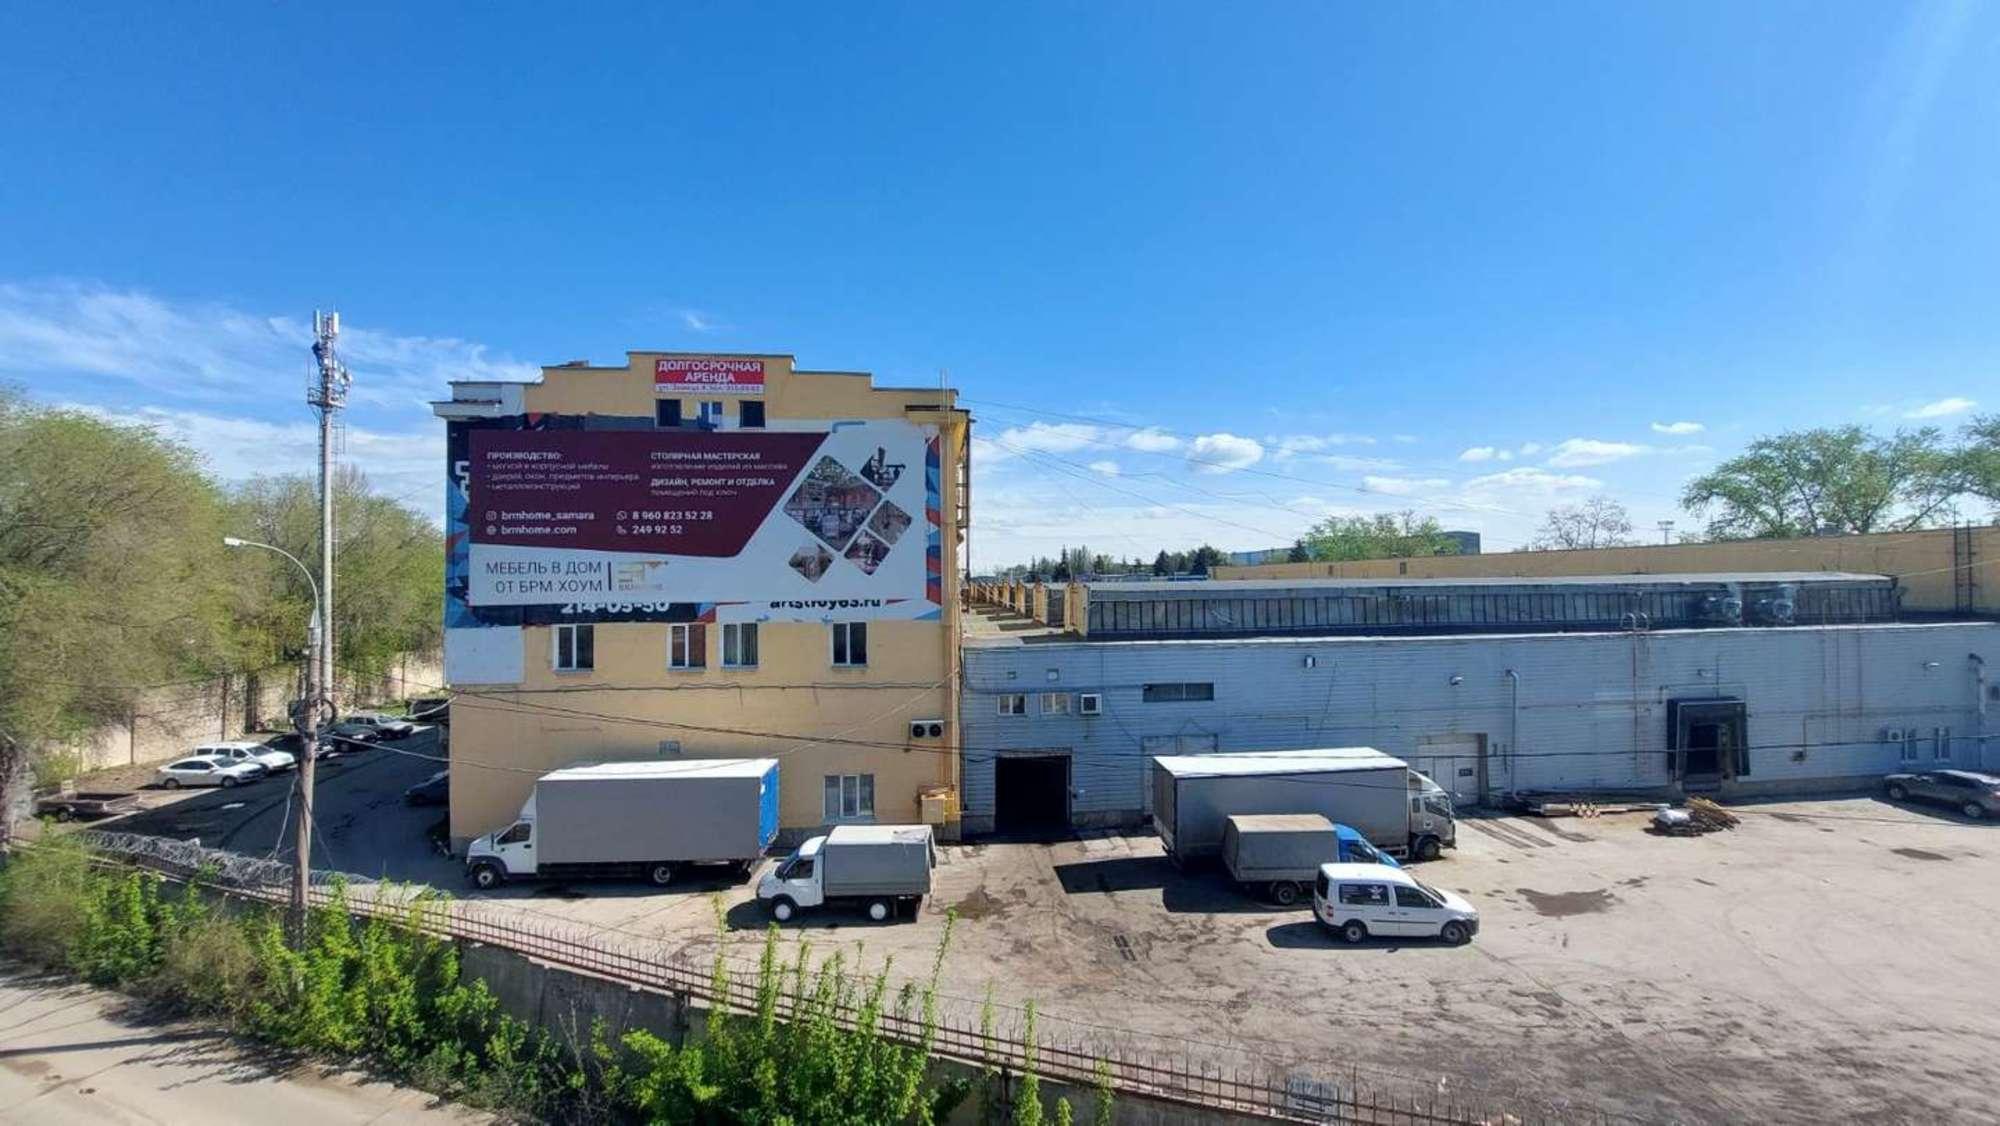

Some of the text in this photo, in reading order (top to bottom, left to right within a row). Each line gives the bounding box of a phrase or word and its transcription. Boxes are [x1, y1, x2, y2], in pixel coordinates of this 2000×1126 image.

[658, 360, 761, 372] ДОЛГОСРОЧНАЯ
[684, 372, 736, 383] АРЕНДА
[650, 452, 761, 460] СТОЛЯРНАЯ МАСТЕРСКАЯ
[651, 478, 688, 487] ДИЗАЙН,
[690, 478, 727, 486] РЕМОНТ
[735, 478, 775, 487] ОТДЕЛКА
[501, 510, 595, 521] brmhome_samara
[632, 511, 713, 520] 8 960 823 52 28
[501, 525, 577, 535] brmhome.com
[632, 525, 683, 534] 249 92 52
[486, 562, 600, 575] МЕБЕЛЬ В ДОМ
[496, 580, 514, 593] ОТ
[519, 580, 551, 593] БРМ
[558, 580, 602, 592] ХОУМ
